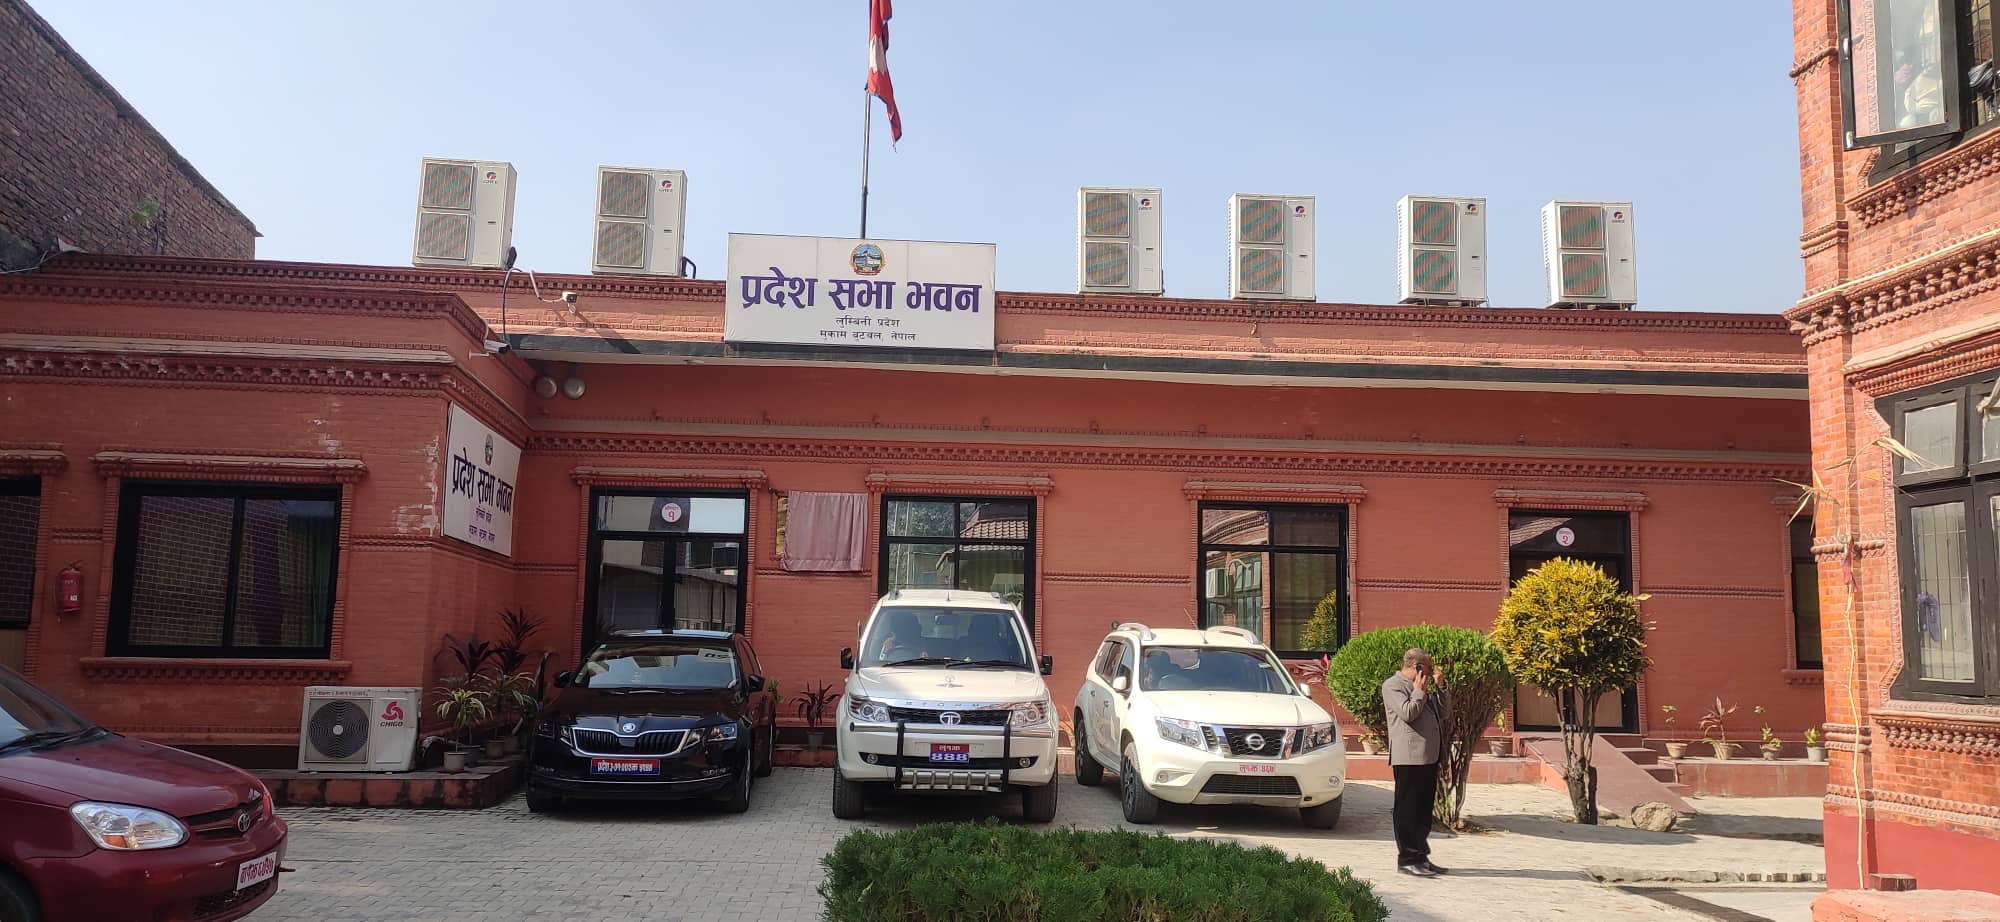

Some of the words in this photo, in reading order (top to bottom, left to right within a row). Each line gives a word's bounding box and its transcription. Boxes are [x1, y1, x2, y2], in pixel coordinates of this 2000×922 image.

[740, 266, 818, 309] प्रदेश
[828, 278, 896, 311] सभा
[906, 281, 982, 312] भवन
[820, 329, 847, 340] मुकाम
[891, 331, 916, 341] नेपाल
[835, 314, 872, 328] लुम्बिनी
[877, 317, 900, 327] प्रदेश
[452, 447, 476, 499] प्रदेश
[477, 467, 496, 507] सभा
[496, 478, 514, 516] भवन
